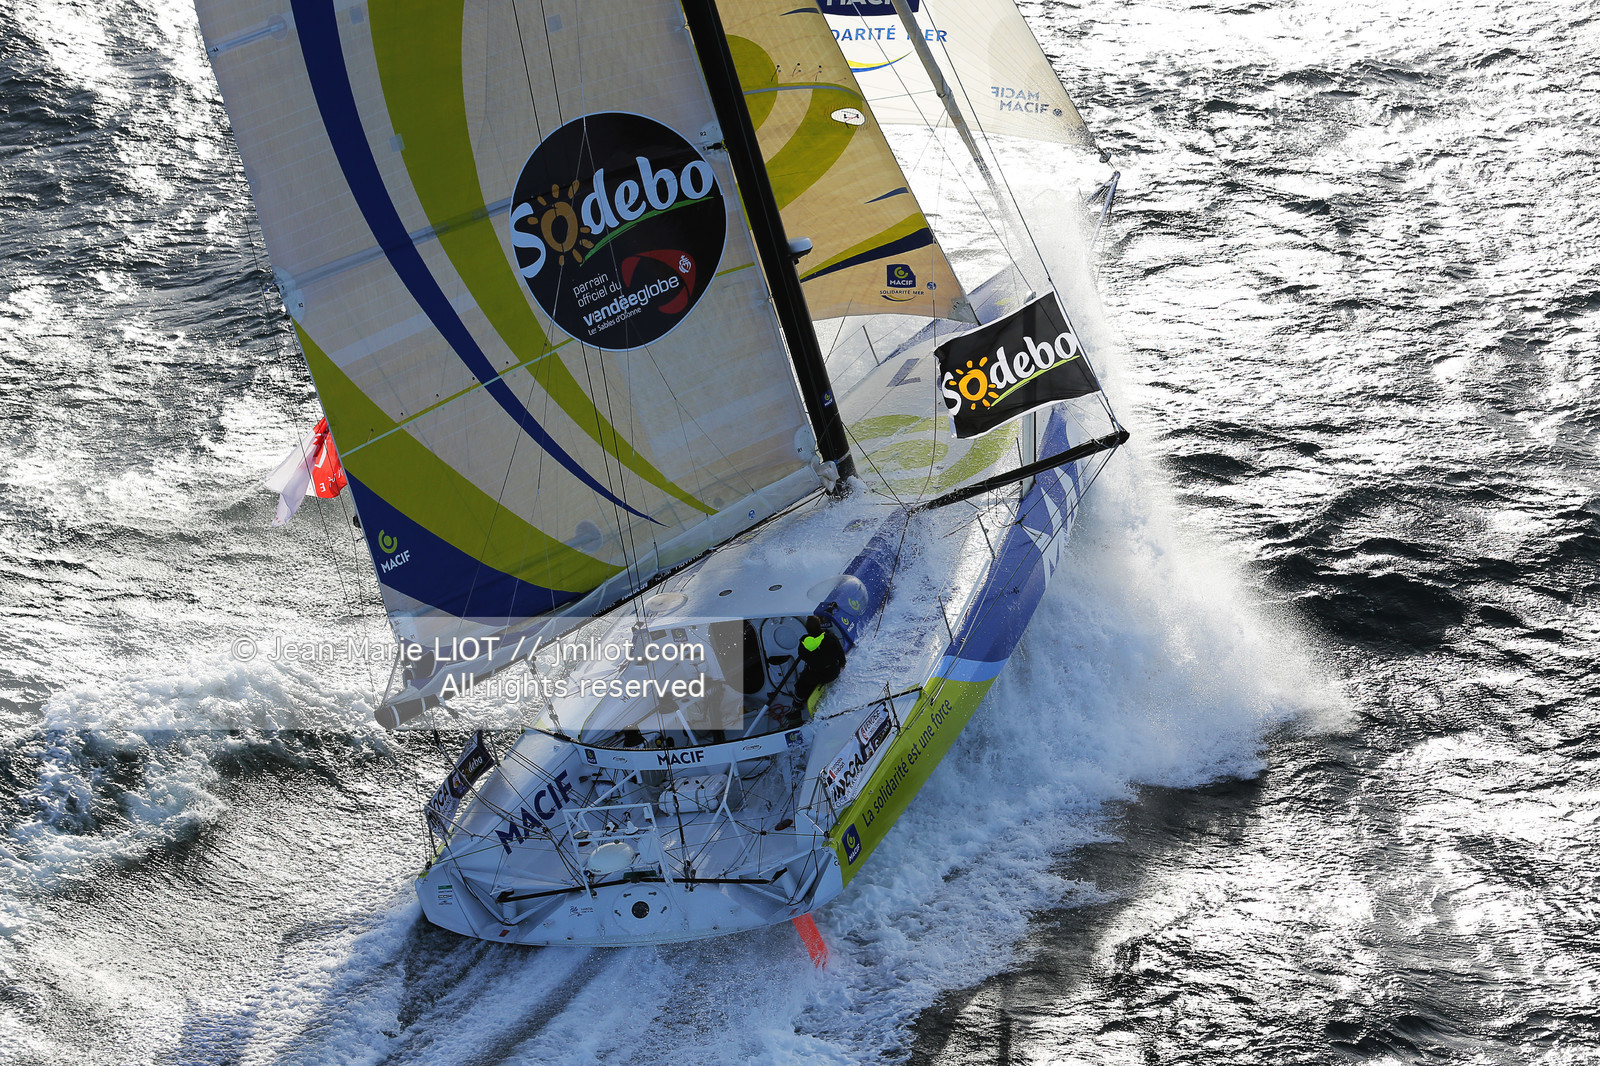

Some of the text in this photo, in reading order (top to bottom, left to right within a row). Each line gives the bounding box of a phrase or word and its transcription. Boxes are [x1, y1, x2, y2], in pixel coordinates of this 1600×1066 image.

[1000, 100, 1050, 114] MACIF
[509, 156, 714, 279] Sodebo
[573, 273, 608, 298] parrain
[577, 281, 622, 308] officiel du
[597, 319, 616, 332] Sables
[941, 332, 1078, 416] Sodebo
[380, 550, 411, 574] MACIF
[656, 749, 706, 766] MACIF
[862, 809, 875, 828] La
[873, 758, 909, 815] solidarité
[907, 742, 922, 766] est
[918, 727, 935, 750] une
[930, 698, 953, 730] force
[494, 769, 573, 855] MACIF
